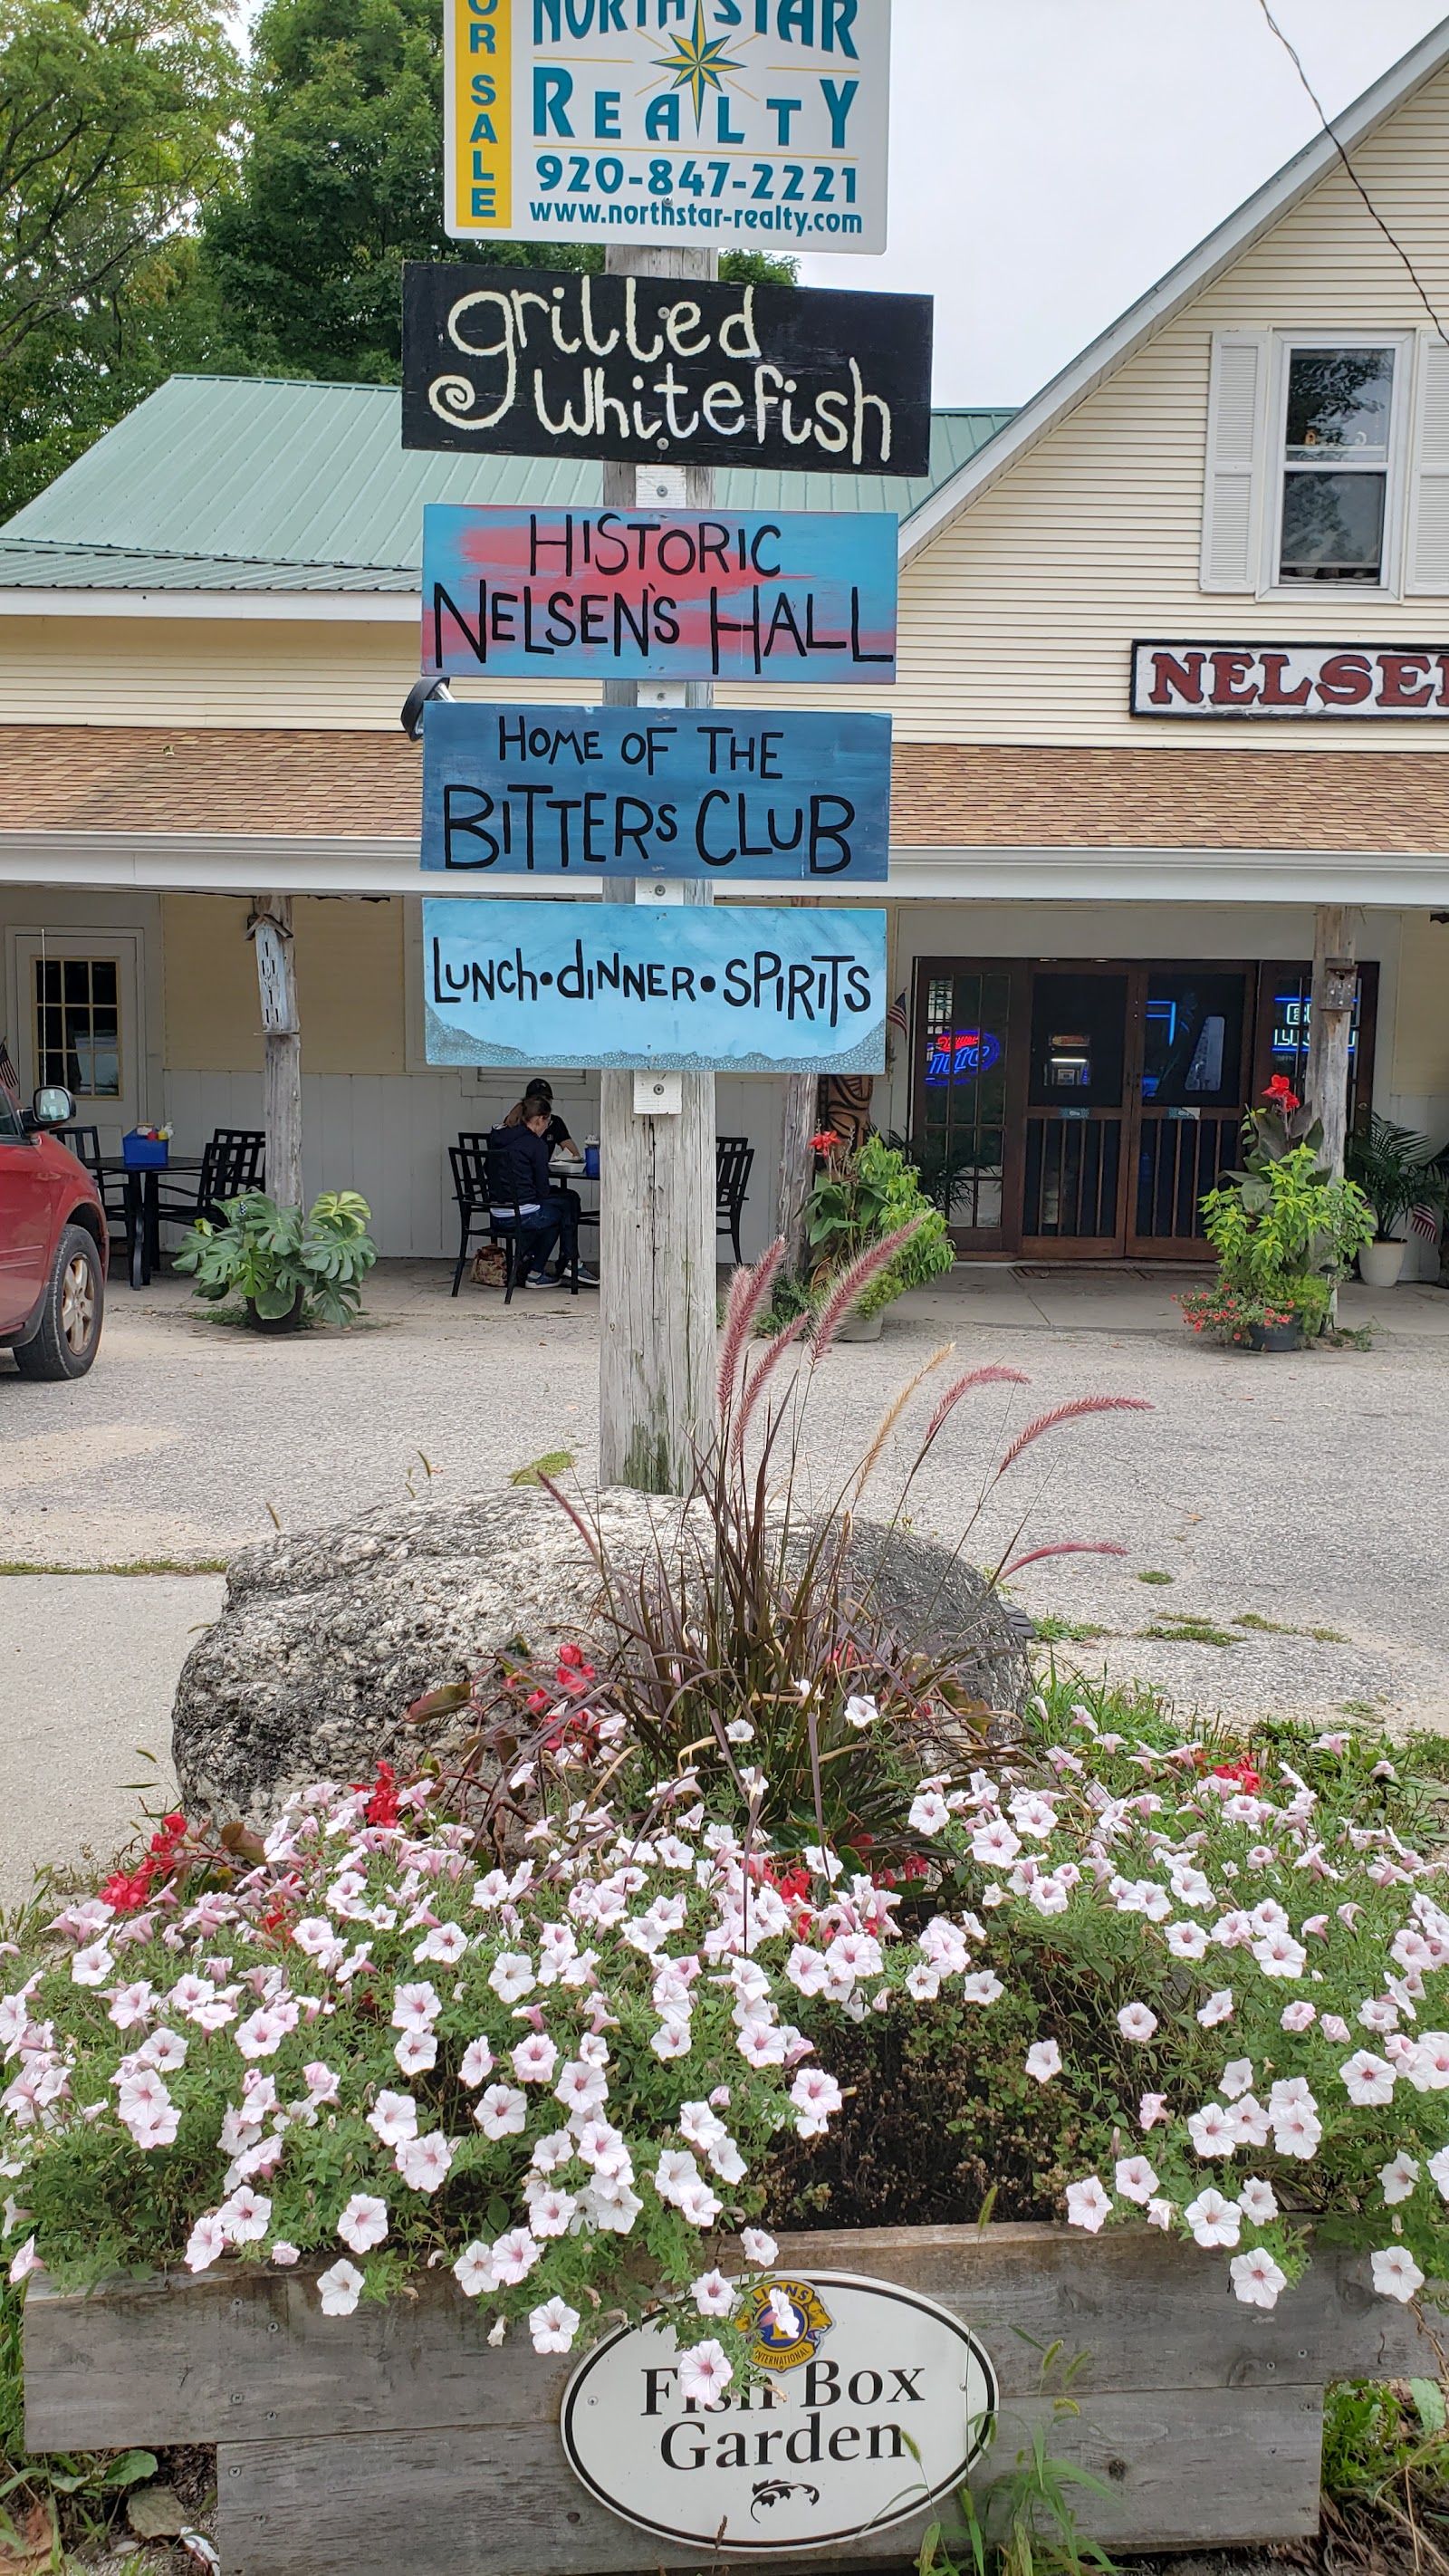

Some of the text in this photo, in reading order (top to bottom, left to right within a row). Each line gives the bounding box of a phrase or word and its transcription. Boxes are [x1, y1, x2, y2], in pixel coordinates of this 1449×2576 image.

[533, 66, 860, 149] REALTY
[468, 74, 498, 217] SALE
[535, 154, 857, 204] 920-847-2221
[529, 199, 863, 237] www.northstar-realty.com
[428, 274, 763, 430] grilled
[529, 513, 782, 578] HISTORIC
[434, 579, 894, 675] NELSEN'S HALL
[1148, 651, 1449, 706] NELSE
[498, 716, 784, 779] HOME OF THE
[443, 784, 856, 873] BITTERS CLUB
[799, 2359, 926, 2408] Box
[659, 2411, 907, 2471] Garden
